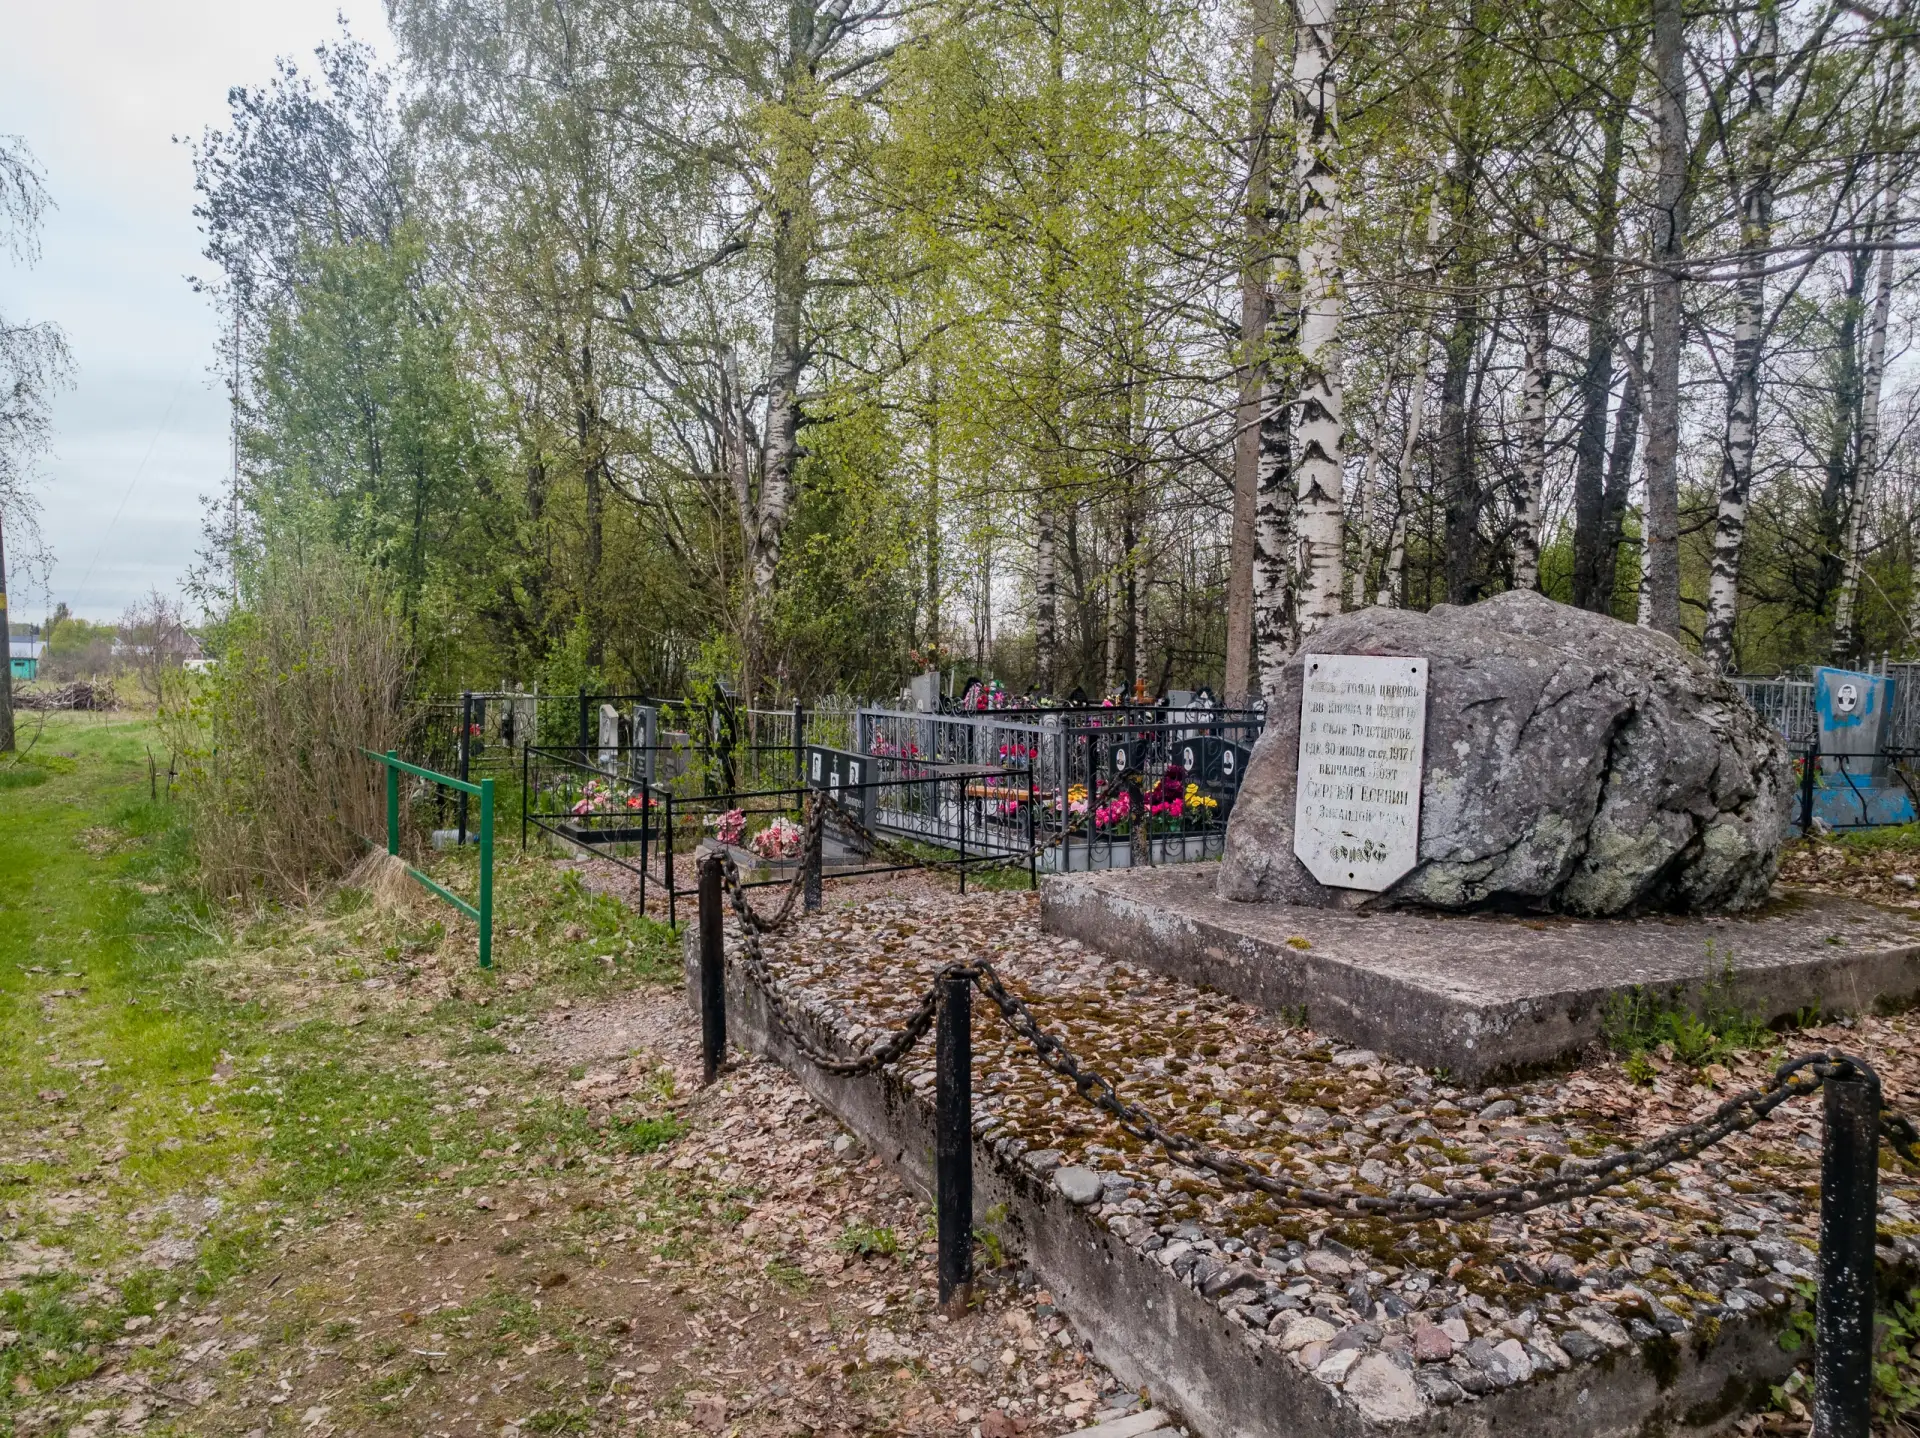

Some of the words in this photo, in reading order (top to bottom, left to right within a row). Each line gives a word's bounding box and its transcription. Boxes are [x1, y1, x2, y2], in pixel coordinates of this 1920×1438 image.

[1380, 685, 1419, 698] ЦЕРКОВЬ
[1325, 742, 1336, 755] 30
[1338, 744, 1365, 757] ИЮЛЯ
[1390, 747, 1408, 760] 1917
[1319, 764, 1366, 777] ВЕНЧАЛСЯ
[1361, 786, 1408, 805] ЕСЕНИН
